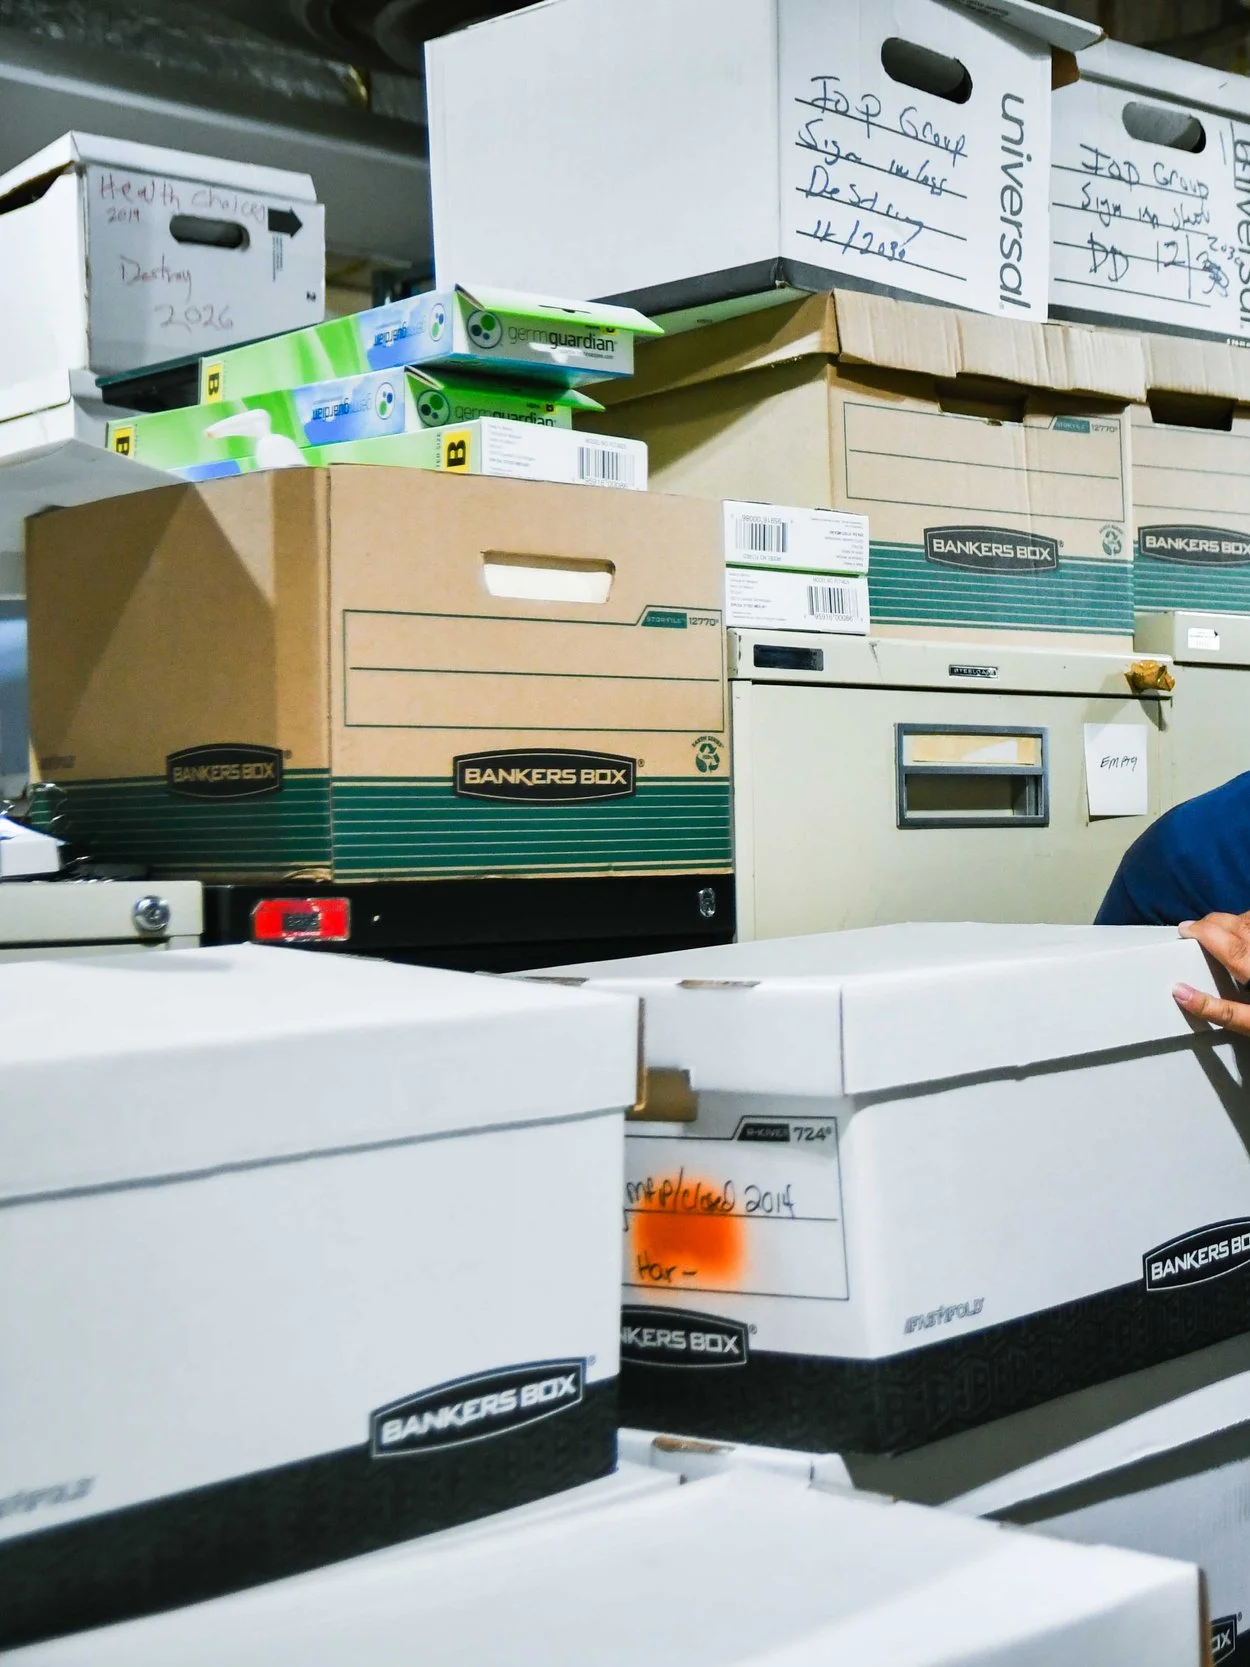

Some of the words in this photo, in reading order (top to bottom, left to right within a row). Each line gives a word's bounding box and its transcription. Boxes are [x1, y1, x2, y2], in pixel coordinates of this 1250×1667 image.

[1000, 93, 1032, 309] universal
[507, 324, 615, 352] germguardian
[446, 439, 467, 468] B
[932, 538, 1014, 557] BANKERS
[1016, 545, 1052, 561] BOX
[1145, 535, 1220, 553] BANKERS
[688, 616, 717, 627] 12770
[172, 762, 241, 784] BANKERS
[242, 761, 277, 781] BOX
[464, 768, 577, 787] BANKERS
[580, 768, 628, 786] BOX
[793, 1126, 827, 1142] 724
[1150, 1240, 1230, 1280] BANKERS
[620, 1326, 687, 1349] NKERS
[689, 1331, 740, 1354] BOX
[380, 1388, 518, 1445] BANKERS
[520, 1373, 578, 1408] BOX
[1211, 1628, 1232, 1654] OX
